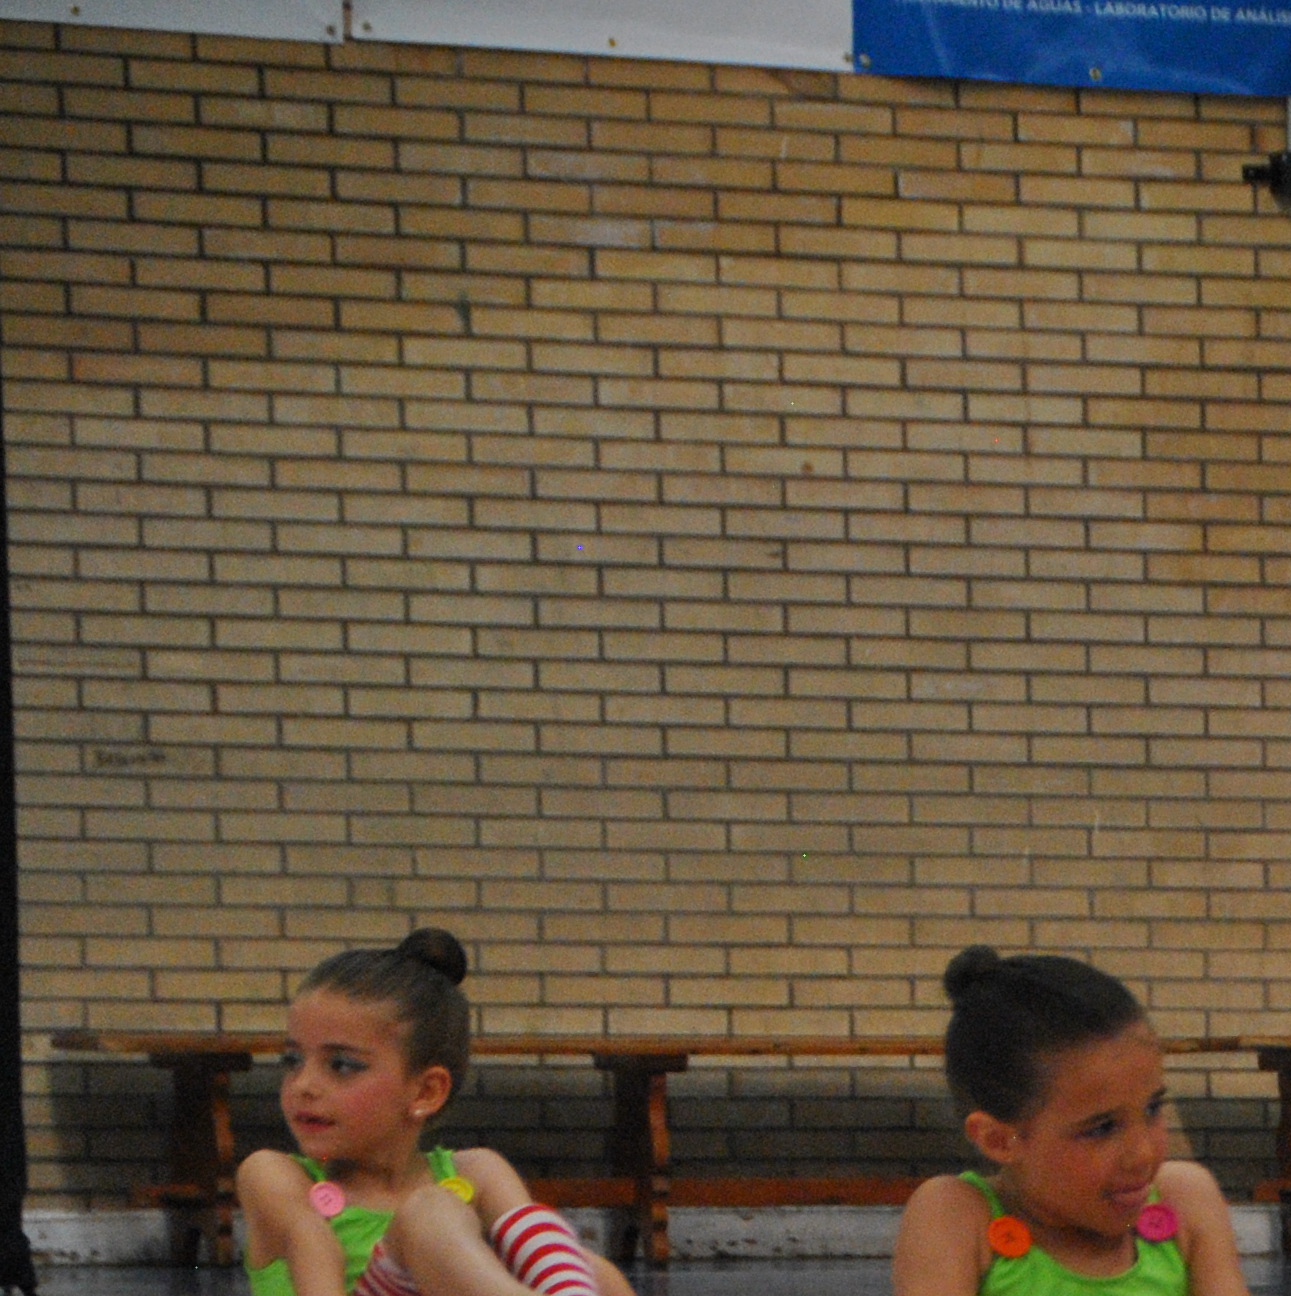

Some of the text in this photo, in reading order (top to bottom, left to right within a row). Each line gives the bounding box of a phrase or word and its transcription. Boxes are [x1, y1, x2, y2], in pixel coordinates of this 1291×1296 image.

[1026, 0, 1082, 14] AGUAS
[1094, 1, 1208, 20] LABORATORIO
[1210, 6, 1231, 21] DE
